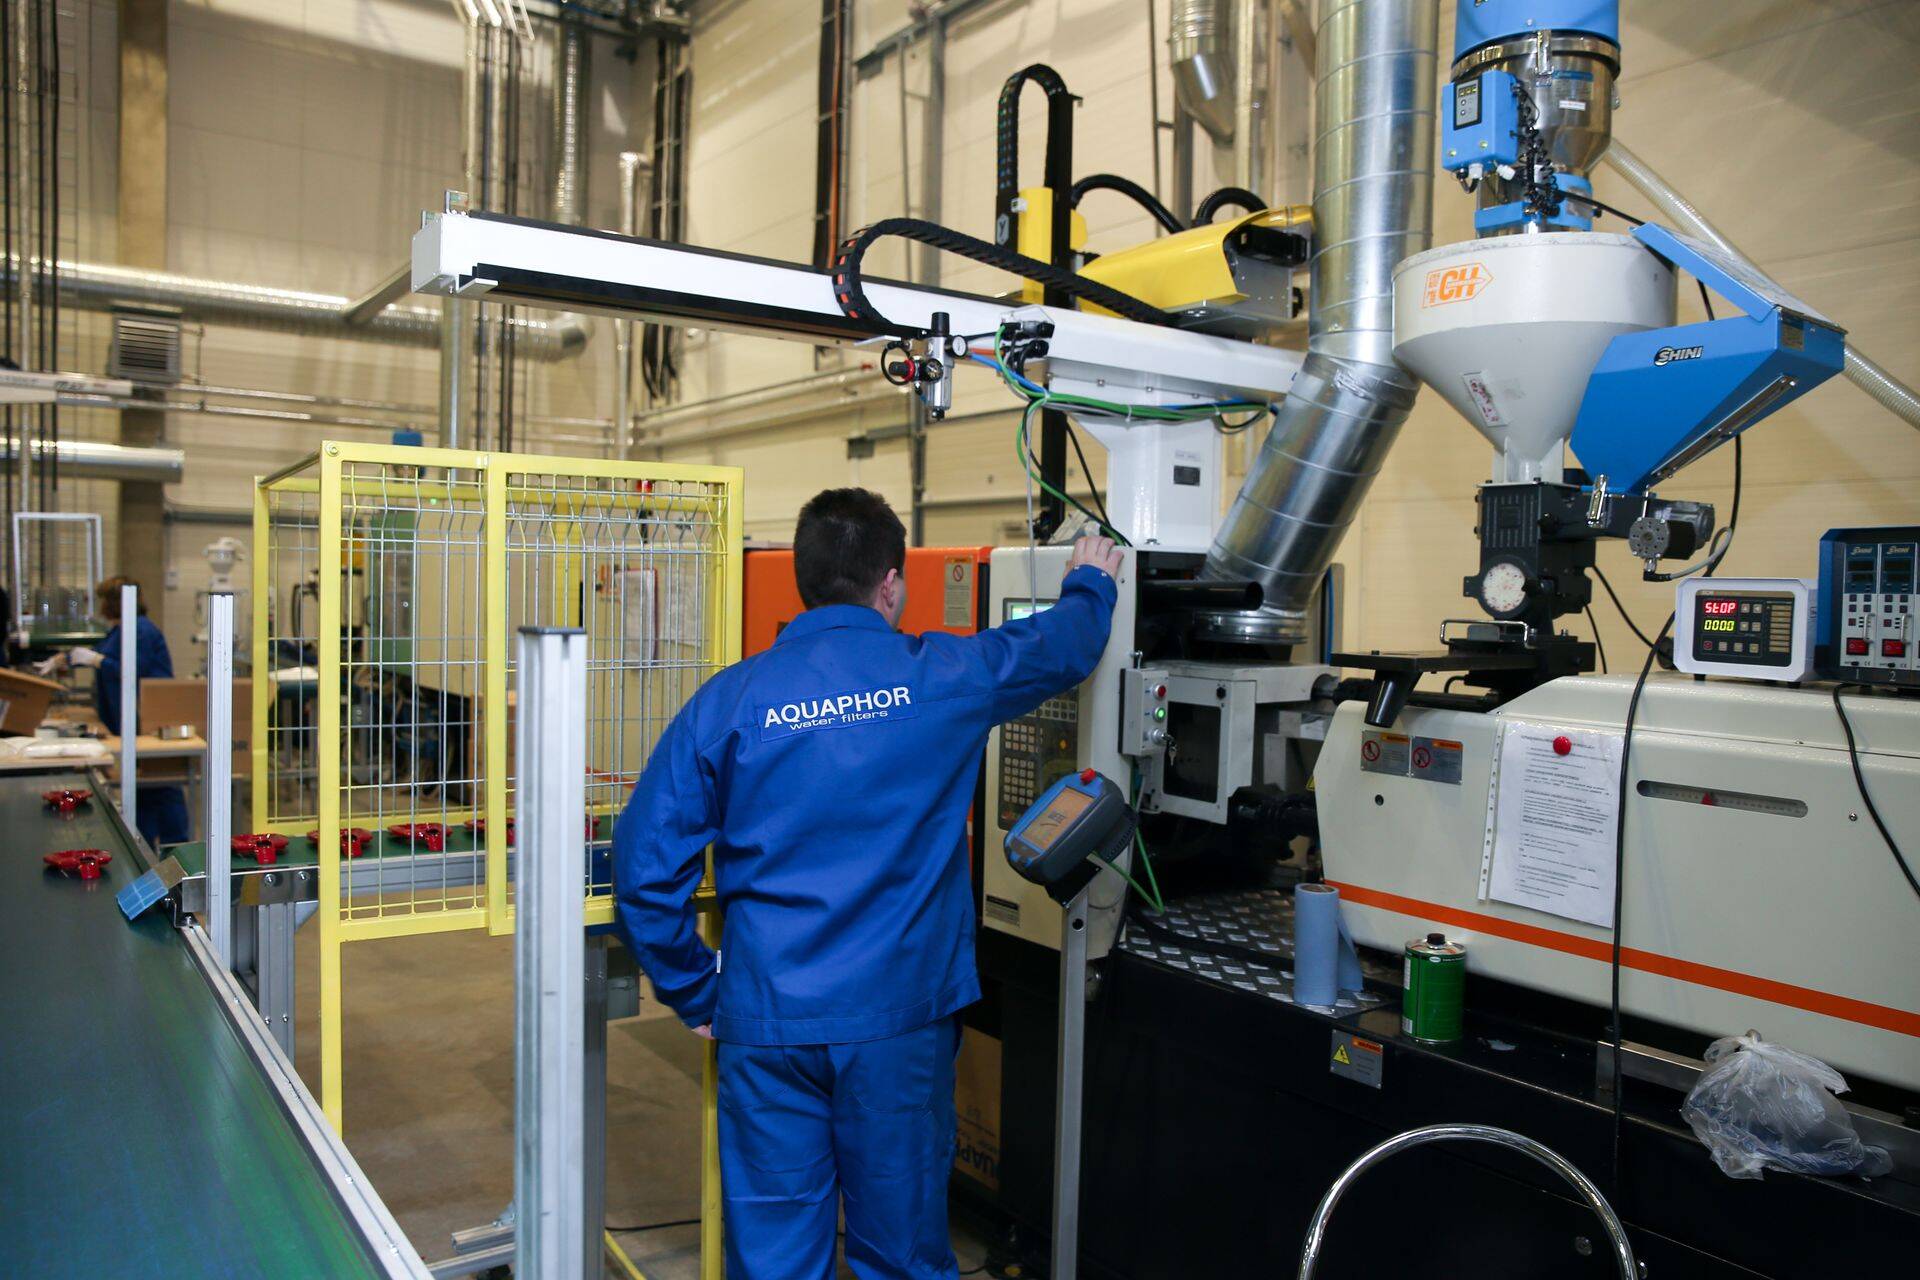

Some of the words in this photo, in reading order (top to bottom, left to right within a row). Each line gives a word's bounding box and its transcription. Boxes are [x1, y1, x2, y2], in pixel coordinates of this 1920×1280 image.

[1439, 266, 1480, 301] CH
[1655, 346, 1704, 365] SHINI
[1704, 619, 1735, 631] 0000
[1889, 670, 1896, 682] 2
[765, 686, 911, 728] AQUAPHOR
[790, 717, 836, 730] water
[841, 710, 888, 723] filters
